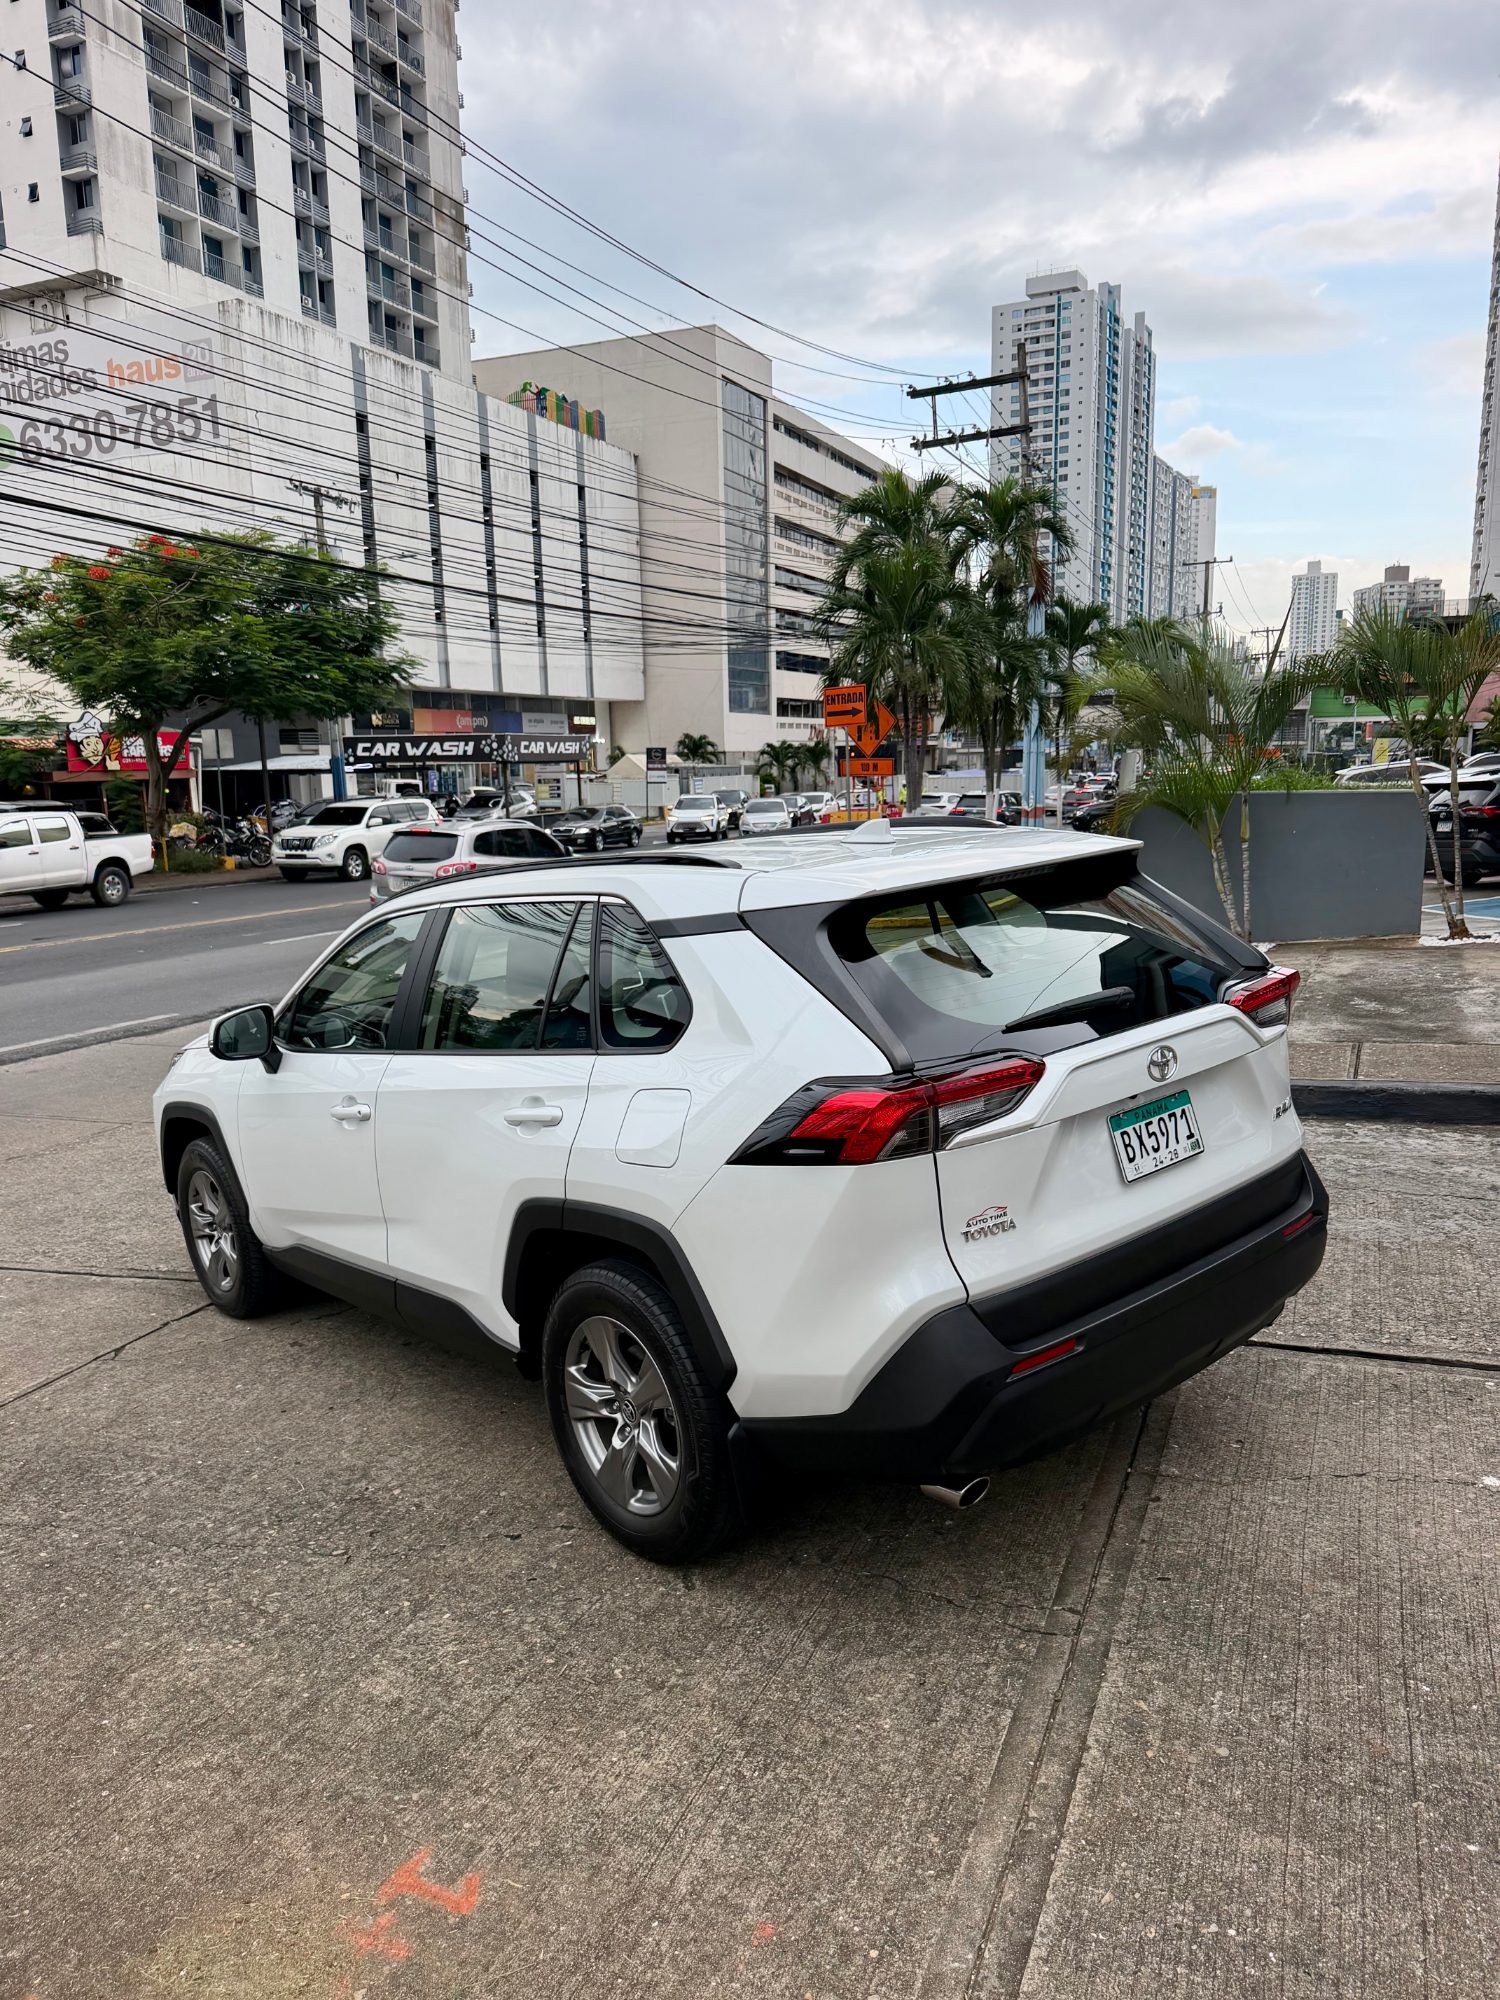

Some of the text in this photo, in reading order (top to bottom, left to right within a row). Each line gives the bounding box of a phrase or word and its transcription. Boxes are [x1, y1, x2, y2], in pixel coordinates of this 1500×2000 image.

[107, 355, 181, 388] haus
[20, 394, 219, 461] 6330-7851
[826, 692, 864, 706] ENTRADA
[356, 742, 474, 756] CAR WASH
[520, 741, 579, 754] CAR WASH
[1134, 1101, 1169, 1121] PANAMA
[1120, 1108, 1195, 1164] BX5971
[1152, 1148, 1179, 1168] 24-28
[966, 1210, 1008, 1228] AUTO TIME
[961, 1218, 1017, 1243] TOYOTA
